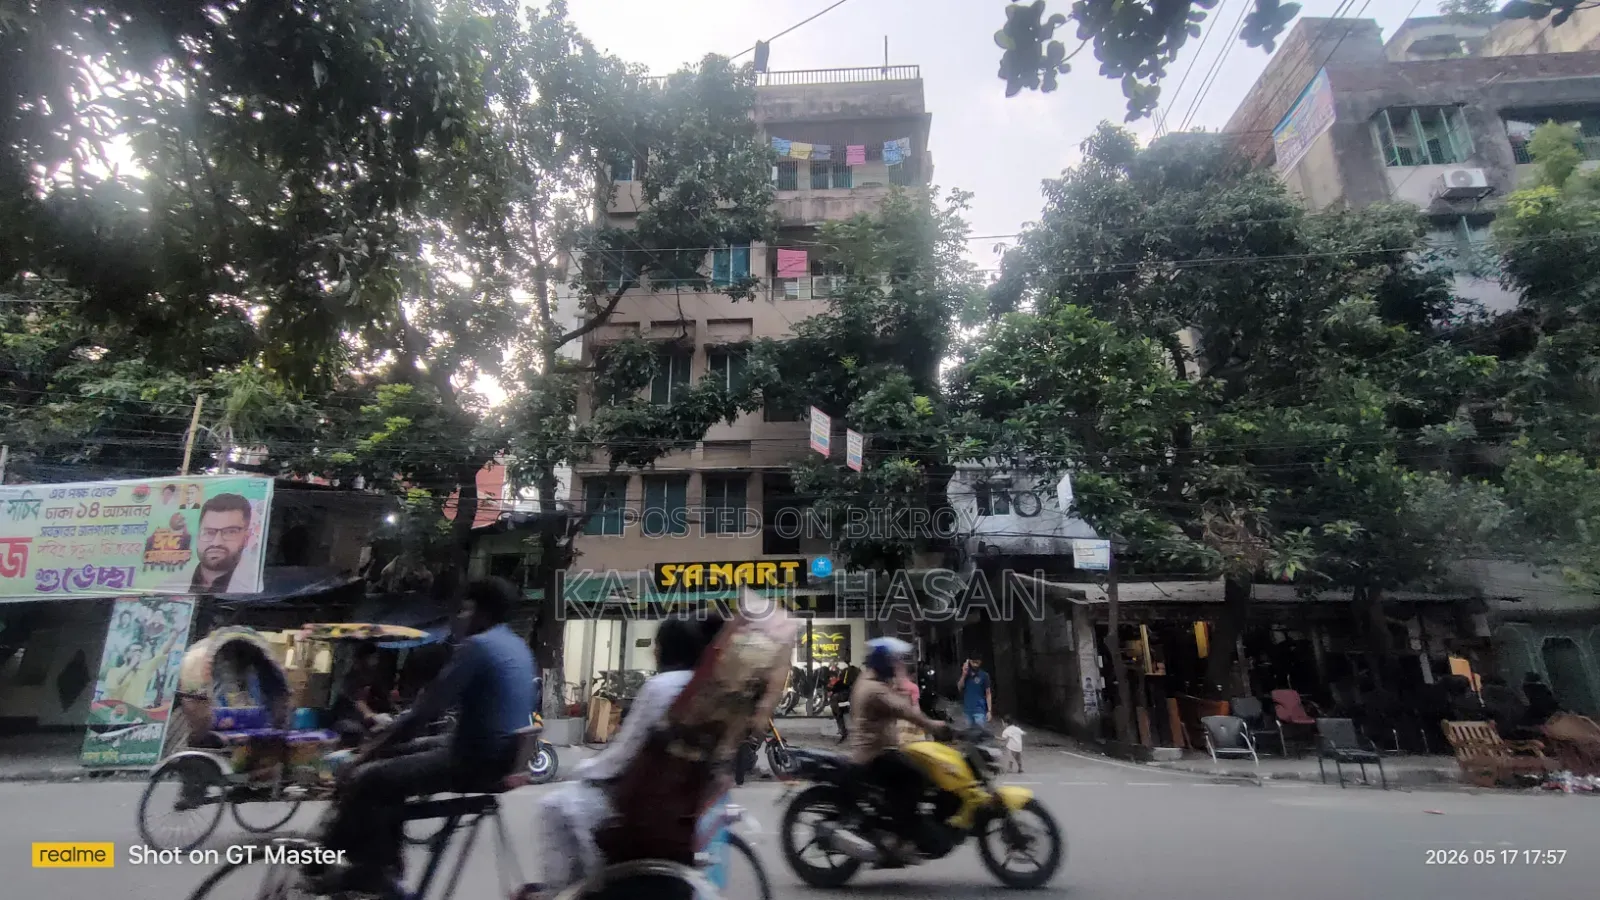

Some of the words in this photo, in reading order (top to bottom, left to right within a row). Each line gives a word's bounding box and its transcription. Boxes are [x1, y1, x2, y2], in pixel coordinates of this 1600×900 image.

[49, 488, 67, 500] এর
[91, 487, 118, 498] থেকে
[45, 507, 74, 519] ঢাকা
[76, 501, 101, 518] ১৪
[35, 564, 136, 593] শুভেচ্ছা
